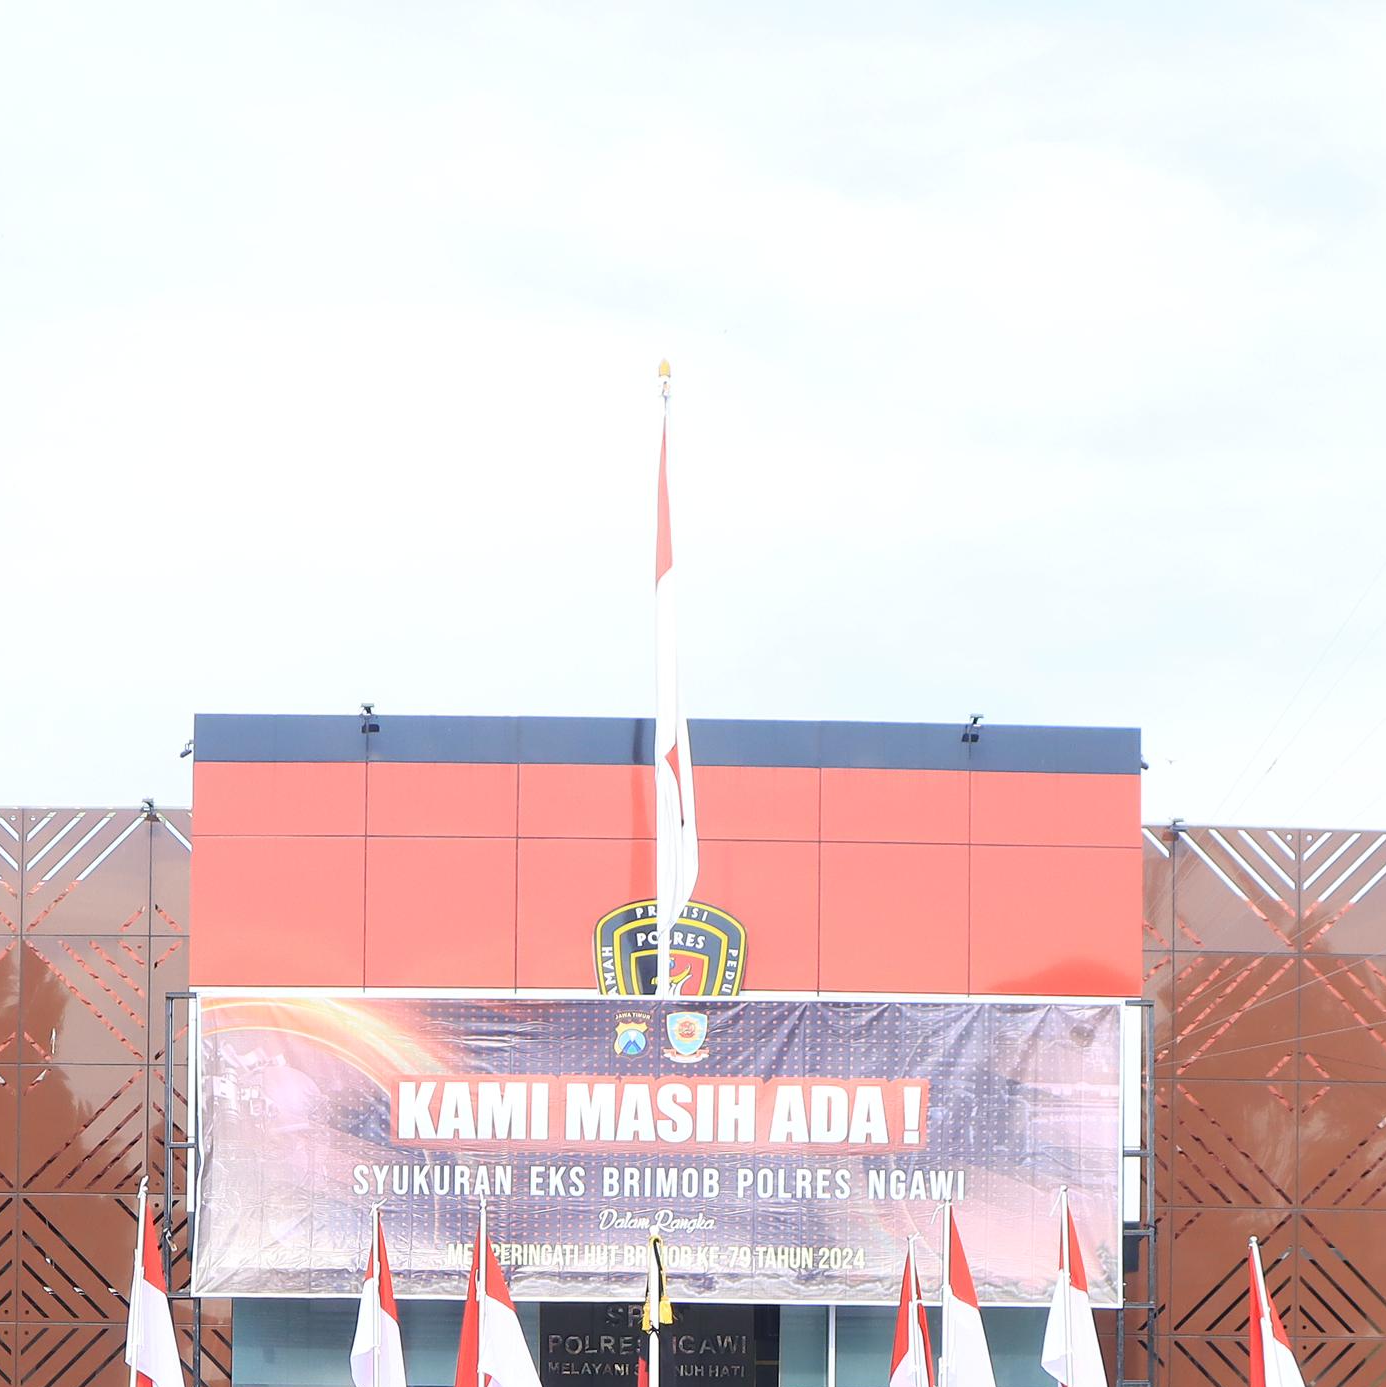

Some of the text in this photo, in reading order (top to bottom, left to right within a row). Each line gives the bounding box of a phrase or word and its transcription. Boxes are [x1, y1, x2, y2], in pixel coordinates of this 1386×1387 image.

[636, 931, 706, 949] PORES
[398, 1081, 550, 1141] KAMI
[565, 1082, 756, 1143] MASIH
[768, 1085, 890, 1144] ADA
[352, 1164, 965, 1200] SYUKURAN EKS BRIMOB POLRES NGAWI
[598, 1208, 715, 1233] Dalam Rangka
[447, 1243, 865, 1269] MEPERINGATI HUT BROB KE-79 TAHUN 2024
[548, 1362, 629, 1376] MELAYANI
[709, 1365, 744, 1378] HATI
